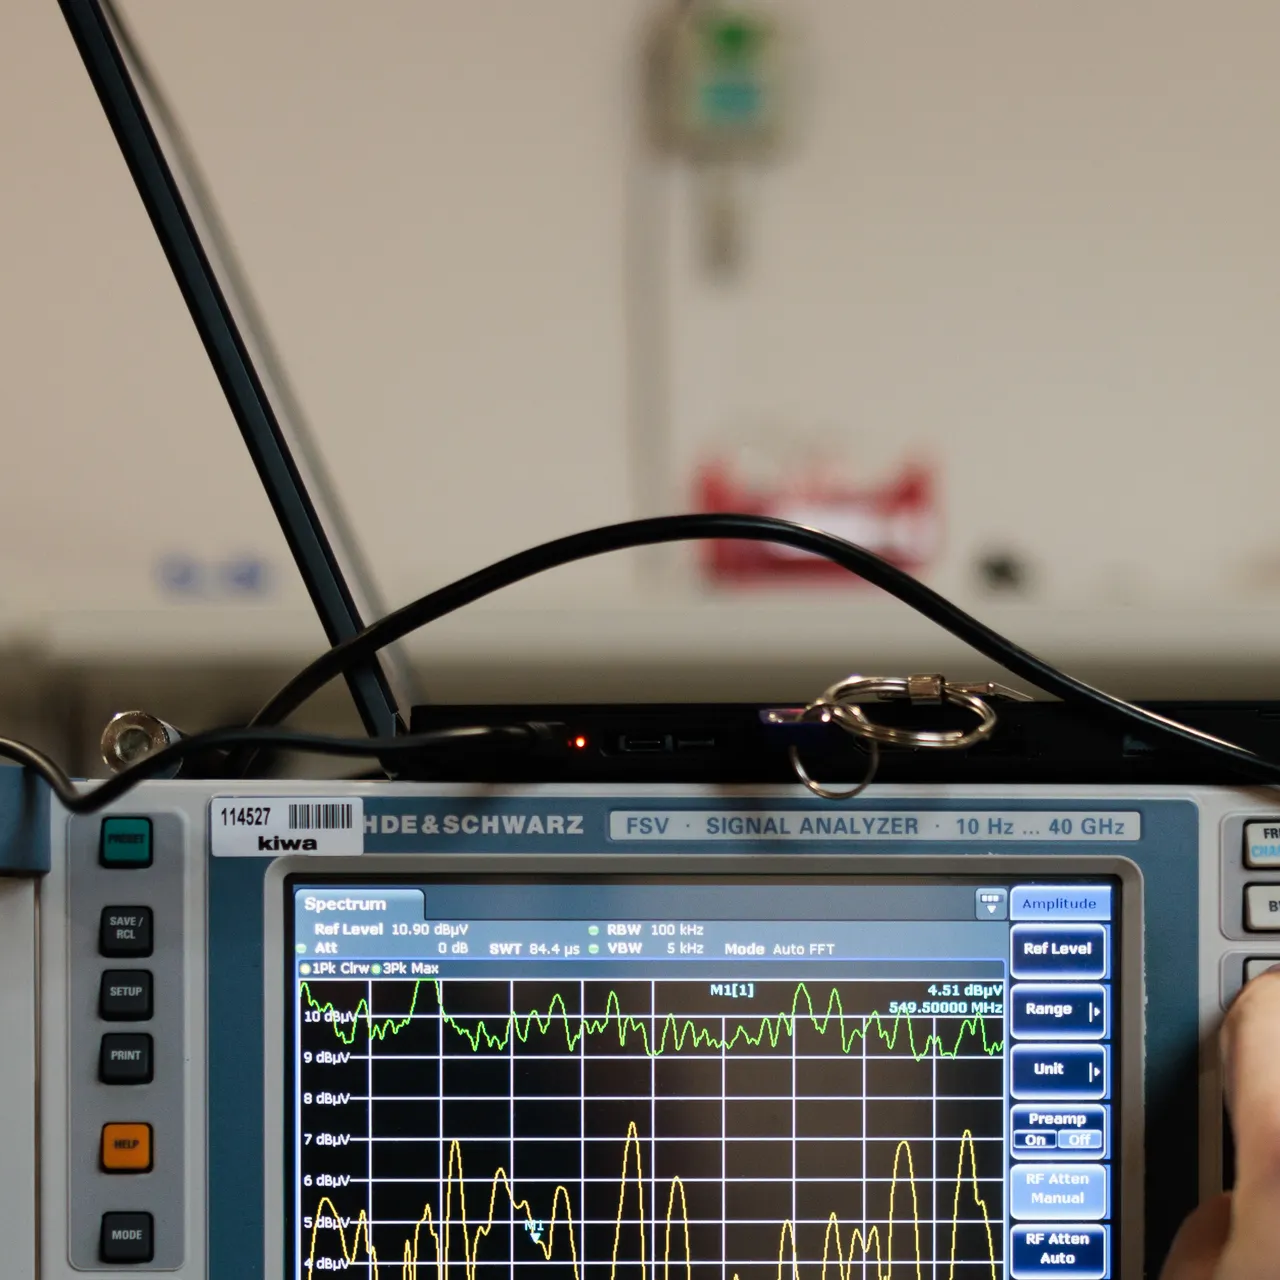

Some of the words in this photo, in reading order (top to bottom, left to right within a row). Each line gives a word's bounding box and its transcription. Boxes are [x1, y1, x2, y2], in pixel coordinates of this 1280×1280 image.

[221, 807, 271, 827] 114527
[626, 817, 669, 834] FSV
[706, 818, 790, 834] SIGNAL
[800, 818, 918, 834] ANALYZER
[956, 818, 982, 835] 10
[988, 818, 1014, 835] Hz
[1049, 818, 1072, 835] 40
[1080, 818, 1124, 836] GHz
[258, 836, 317, 852] kiwa
[304, 898, 386, 914] Spectrum
[1022, 898, 1096, 912] Amplitude
[110, 917, 136, 926] SAVE
[116, 930, 136, 940] RCL
[315, 923, 338, 936] Ref
[342, 923, 383, 936] Level
[392, 924, 430, 936] 10.90
[434, 923, 468, 938] dBµV
[608, 924, 641, 936] RBW
[652, 924, 676, 936] 100
[680, 923, 704, 936] kHz
[315, 942, 337, 954] Att
[438, 942, 446, 954] 0
[450, 942, 468, 954] dB
[489, 942, 522, 956] SWT
[530, 942, 560, 956] 84.4
[564, 945, 580, 958] µs
[608, 942, 642, 955] VBW
[667, 942, 675, 955] 5
[680, 942, 704, 955] kHz
[724, 942, 765, 956] Mode
[773, 943, 805, 956] Auto
[810, 943, 836, 956] FFT
[1024, 942, 1048, 956] Ref
[1051, 942, 1092, 956] Level
[312, 962, 336, 974] 1Pk
[383, 962, 407, 974] 3Pk
[411, 962, 439, 974] Max
[110, 988, 142, 996] SETUP
[710, 983, 754, 998] M1[1]
[928, 984, 960, 996] 4.51
[964, 983, 1003, 999] dBµV
[888, 1002, 967, 1014] 549.50000
[971, 1002, 1003, 1014] MHz
[1026, 1004, 1072, 1018] Range
[305, 1010, 320, 1022] 10
[111, 1051, 141, 1060] PRINT
[304, 1053, 312, 1064] 9
[316, 1052, 350, 1066] dBµV
[1034, 1063, 1064, 1076] Unit
[304, 1094, 312, 1104] 8
[316, 1092, 350, 1106] dBµV
[1029, 1113, 1086, 1128] Preamp
[114, 1140, 140, 1150] HELP
[304, 1135, 312, 1146] 7
[316, 1134, 350, 1148] dBµV
[1025, 1135, 1046, 1146] On
[1069, 1134, 1091, 1146] Off
[304, 1175, 312, 1186] 6
[316, 1174, 350, 1188] dBµV
[1026, 1174, 1044, 1184] RF
[1048, 1174, 1090, 1184] Atten
[1031, 1192, 1084, 1204] Manual
[304, 1217, 312, 1228] 5
[316, 1216, 350, 1230] dBµV
[112, 1230, 142, 1240] MODE
[1026, 1234, 1044, 1244] RF
[1048, 1234, 1090, 1244] Atten
[304, 1258, 312, 1268] 4
[316, 1257, 350, 1270] dBµV
[1040, 1253, 1076, 1264] Auto
